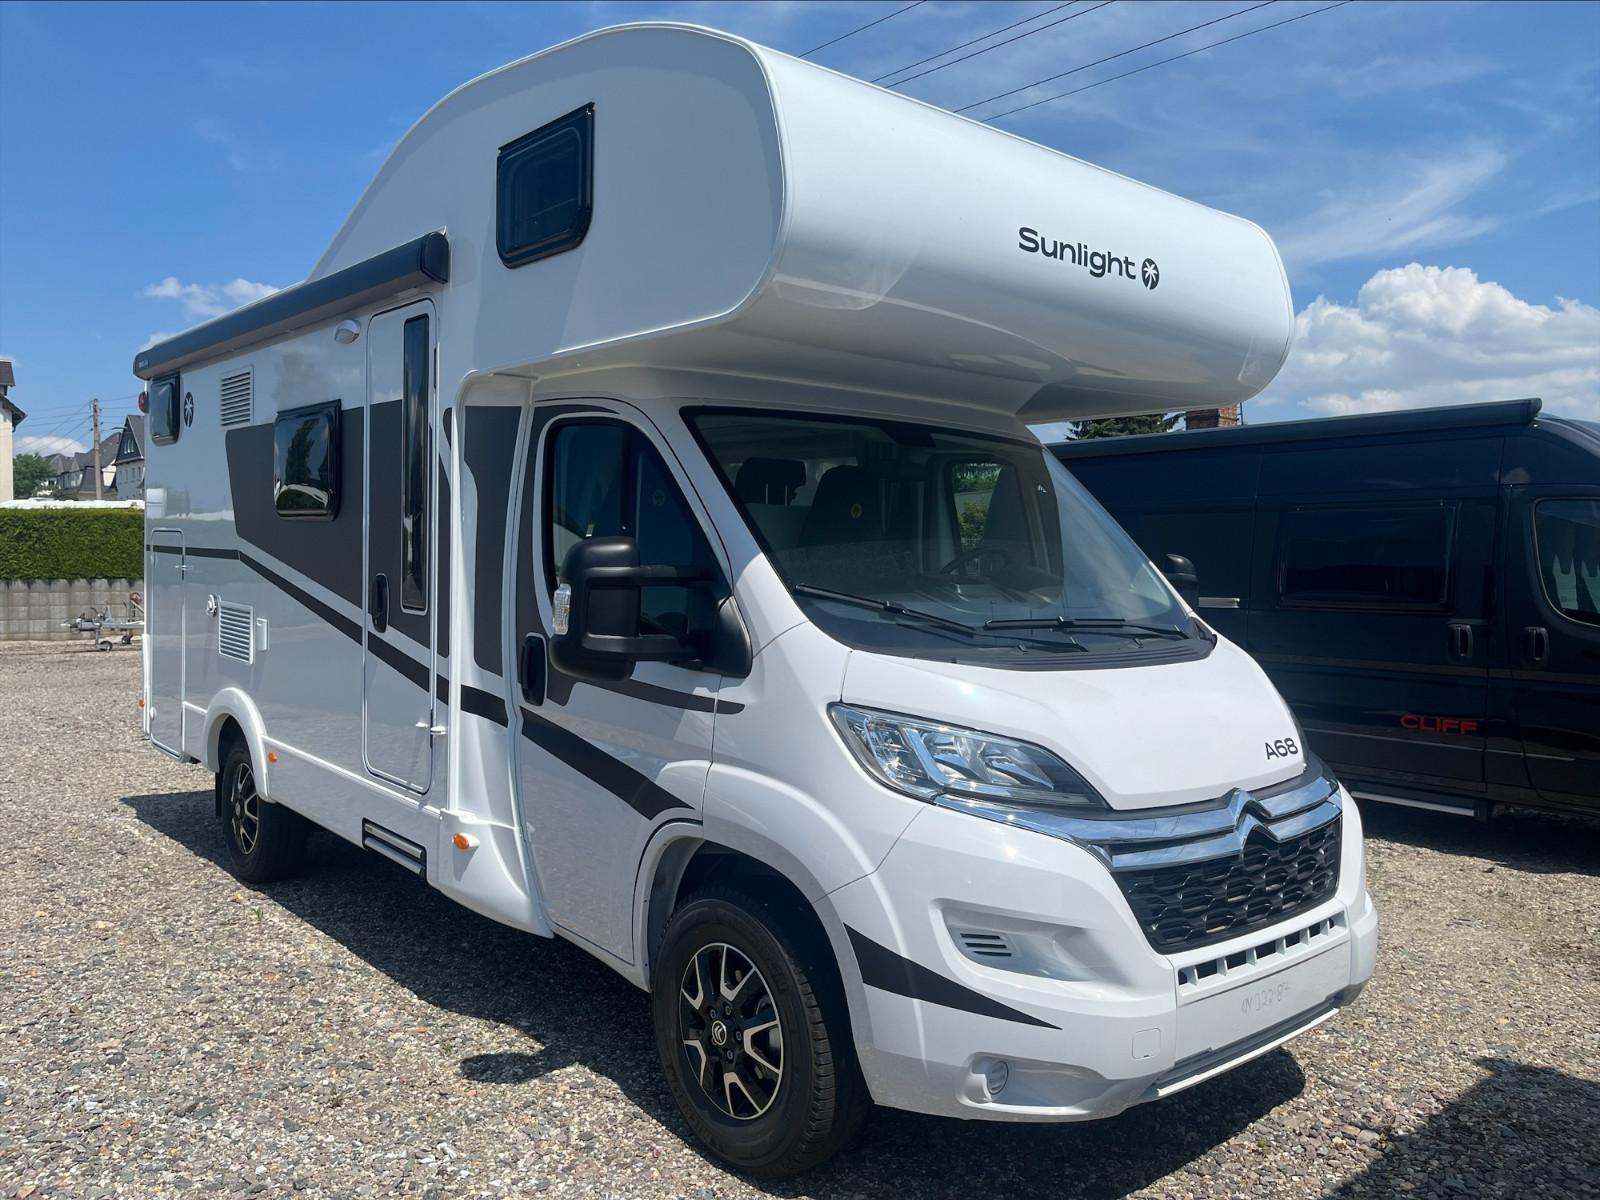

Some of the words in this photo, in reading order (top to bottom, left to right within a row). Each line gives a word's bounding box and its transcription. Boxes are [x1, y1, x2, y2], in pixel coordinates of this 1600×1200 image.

[1018, 226, 1137, 280] Sunlight
[1400, 713, 1478, 734] CLIFF
[1264, 737, 1299, 760] A68
